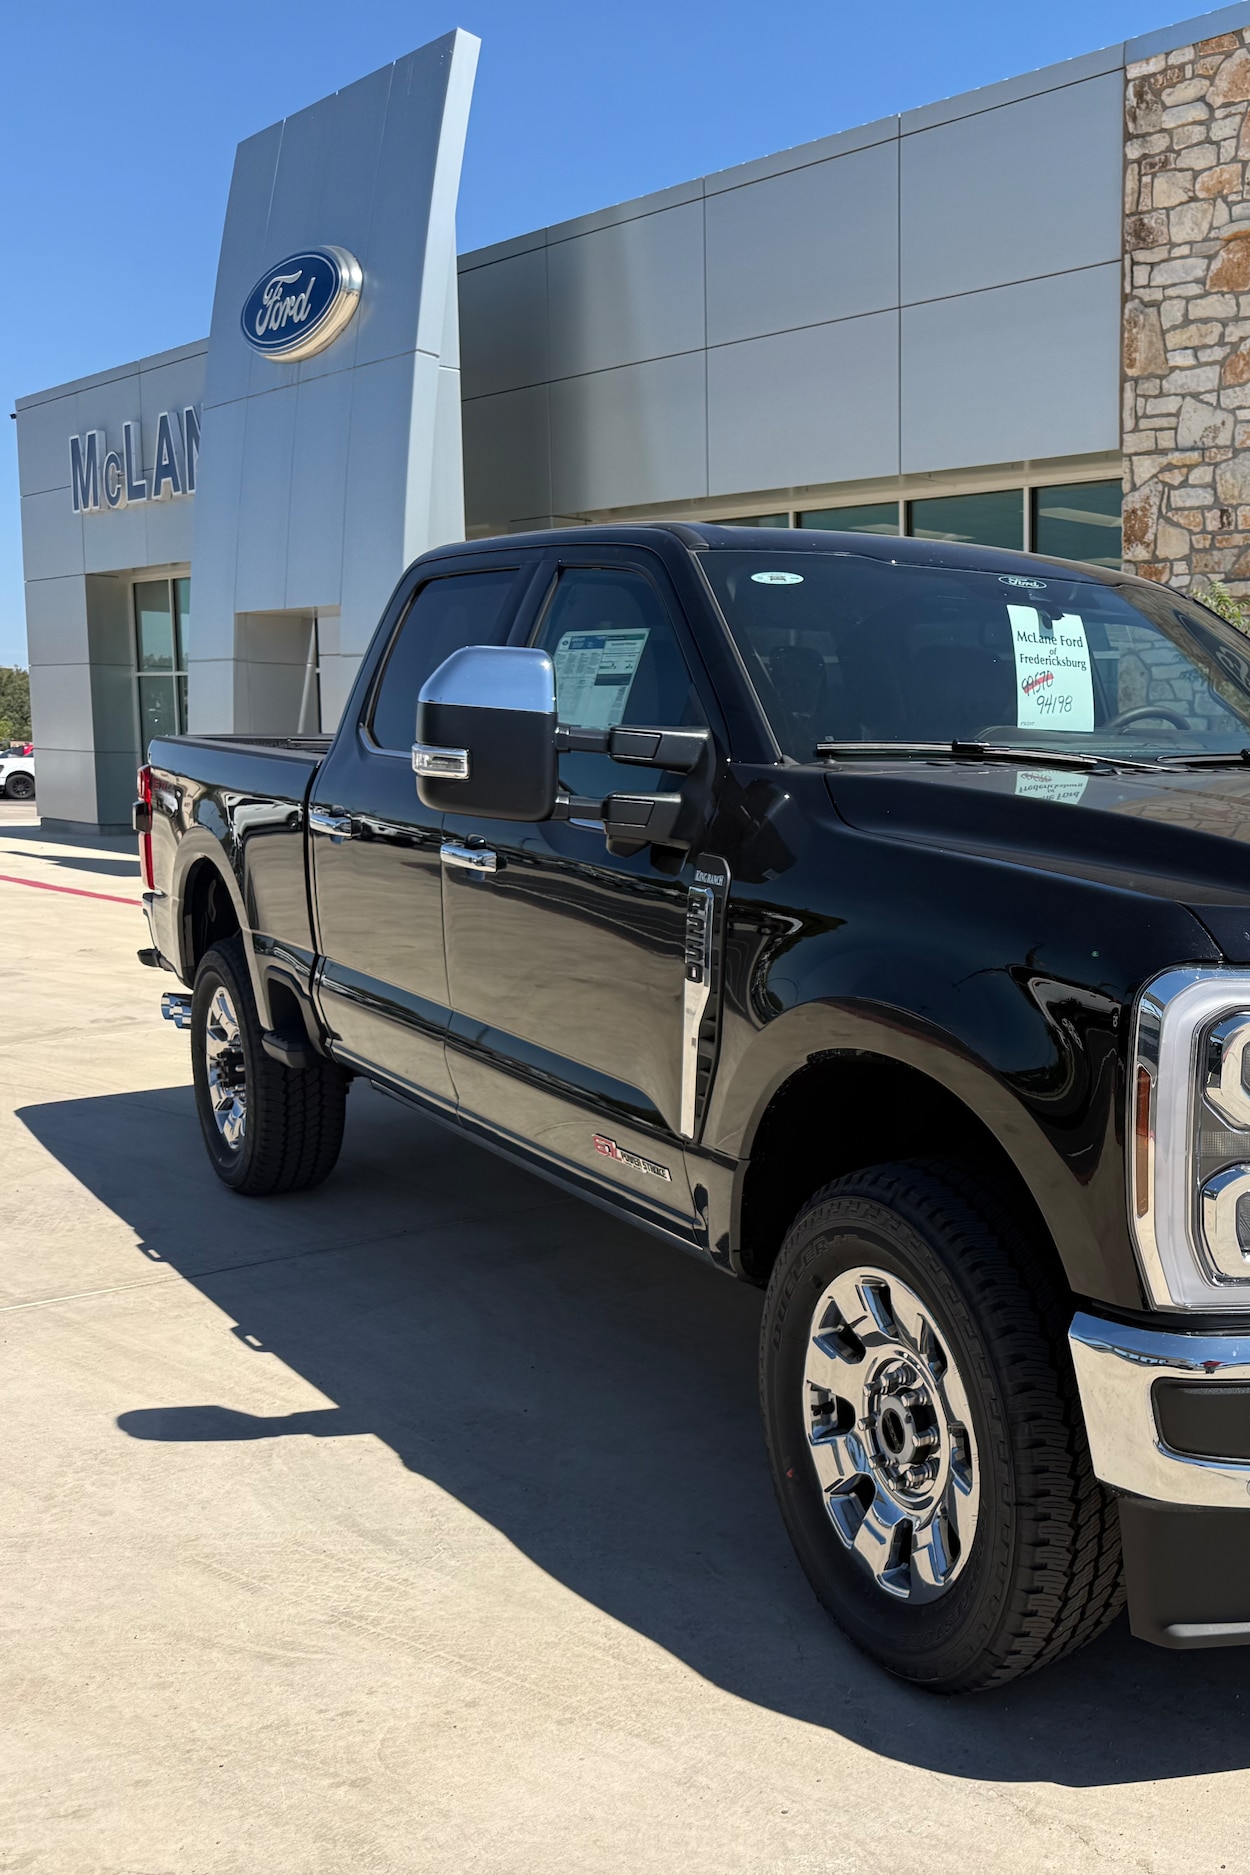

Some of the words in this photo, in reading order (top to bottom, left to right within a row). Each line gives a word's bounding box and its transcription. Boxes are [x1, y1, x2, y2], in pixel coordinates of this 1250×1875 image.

[255, 270, 317, 336] Ford
[1017, 630, 1058, 646] McLane
[1060, 635, 1084, 648] Ford
[1049, 647, 1057, 656] of
[1020, 653, 1087, 672] Fredericksburg
[1036, 694, 1073, 714] 94198
